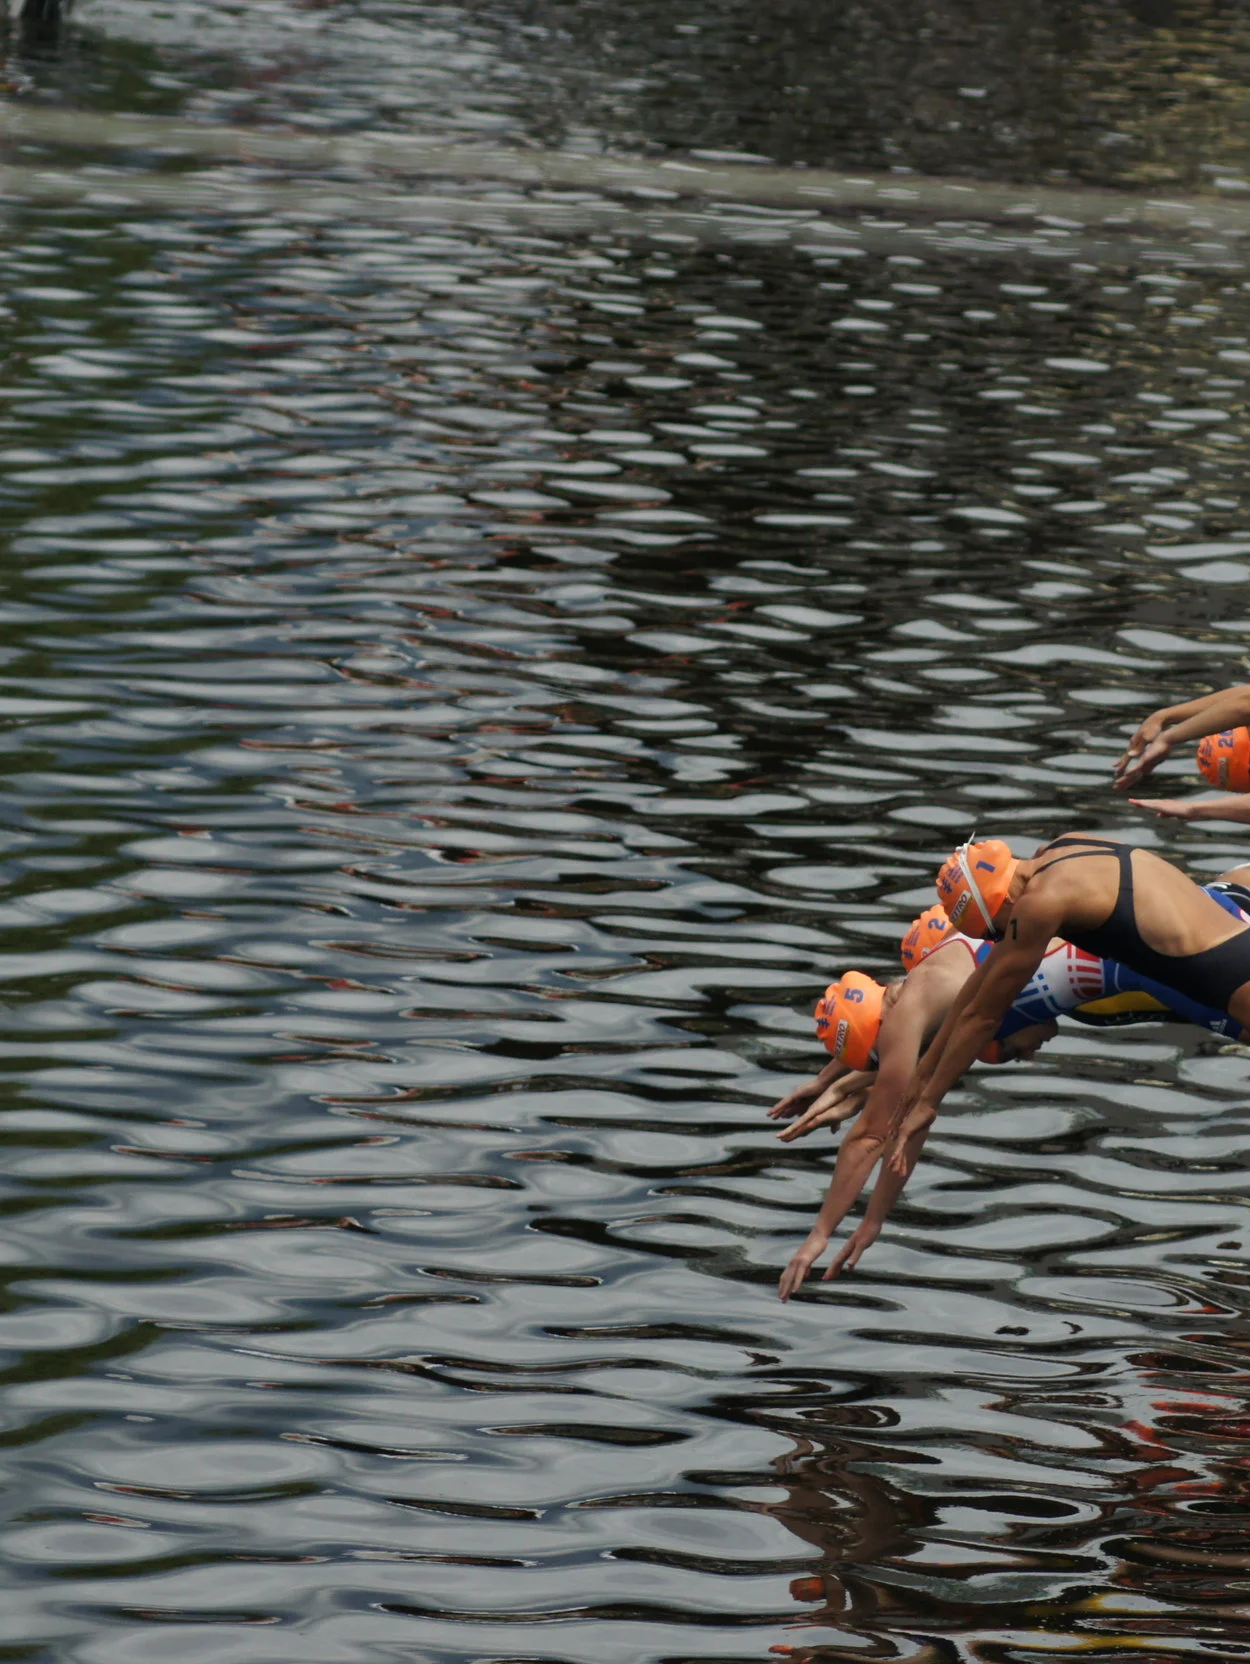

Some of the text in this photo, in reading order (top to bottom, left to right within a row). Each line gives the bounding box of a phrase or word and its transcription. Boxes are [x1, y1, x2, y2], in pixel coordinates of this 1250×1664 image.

[975, 860, 997, 874] 1
[928, 917, 947, 932] 2
[1007, 917, 1019, 941] 1
[844, 987, 865, 1004] 5
